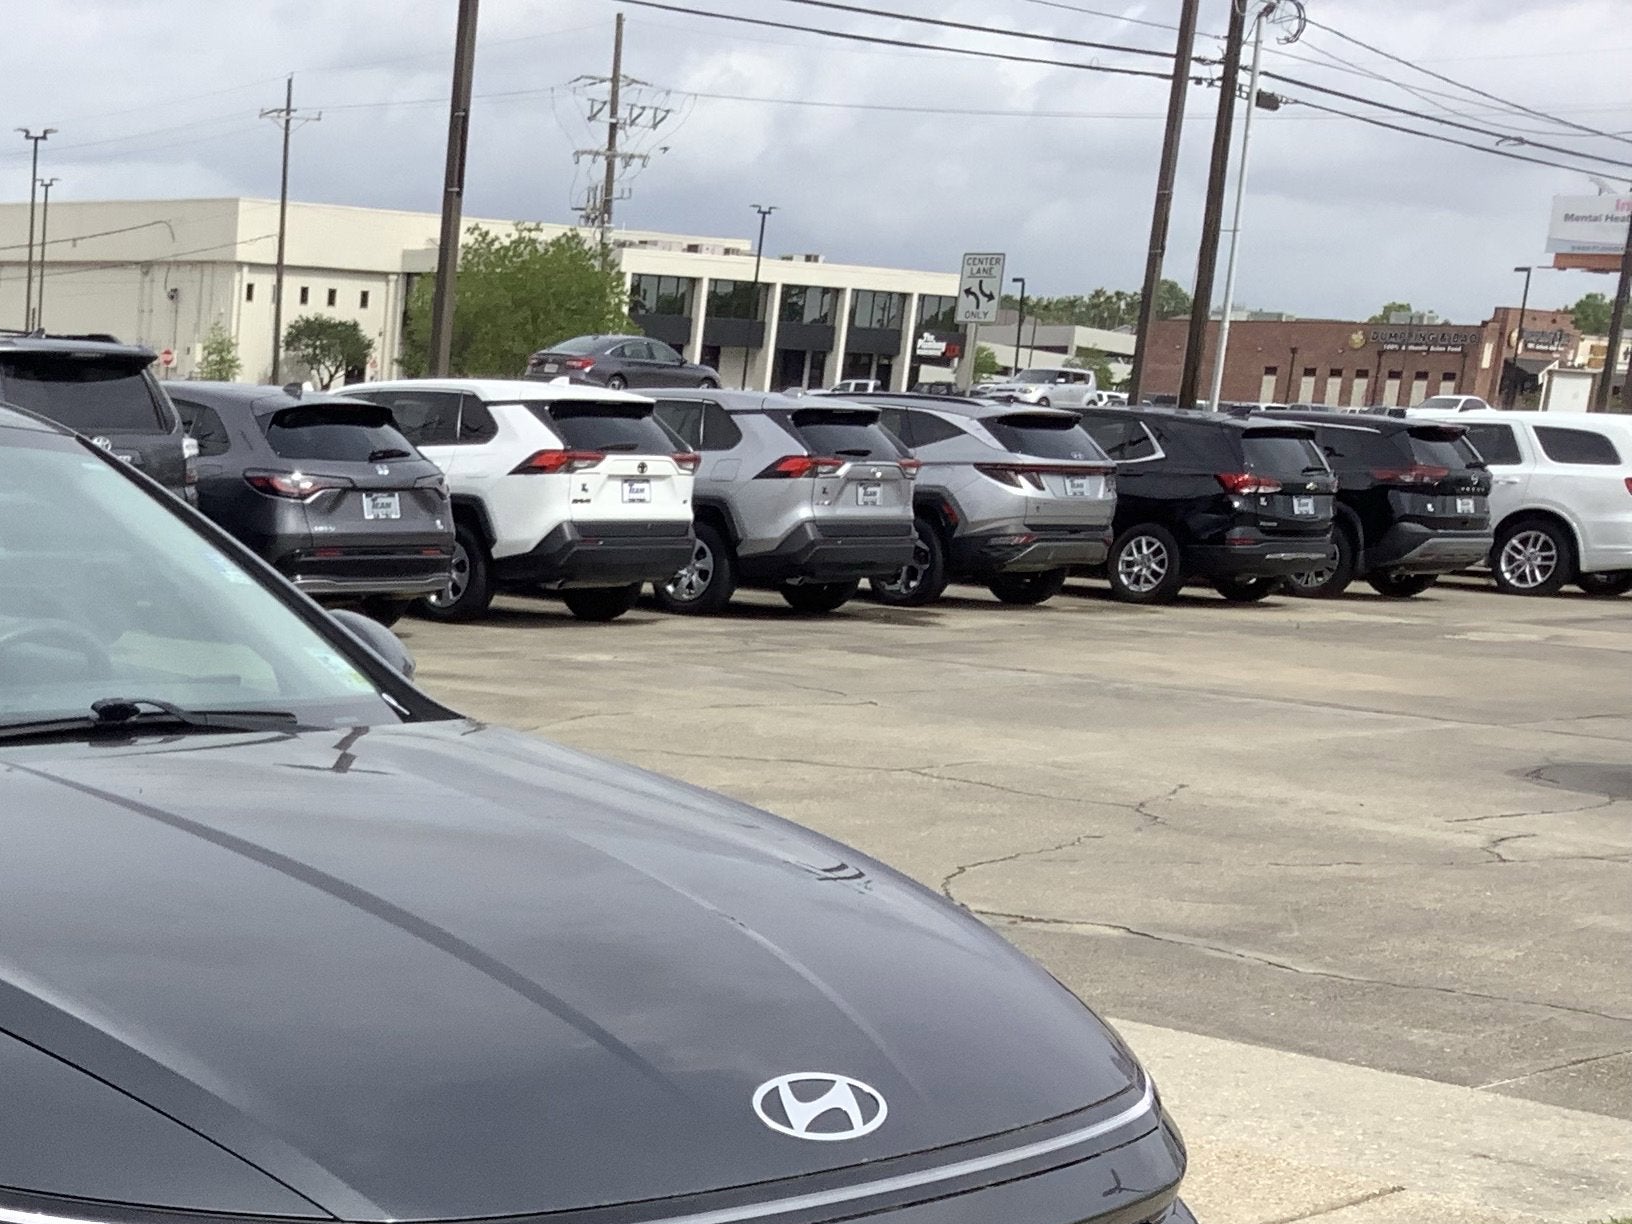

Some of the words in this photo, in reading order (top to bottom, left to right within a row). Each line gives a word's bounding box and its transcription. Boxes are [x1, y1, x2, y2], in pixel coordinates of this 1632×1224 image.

[1564, 213, 1603, 222] Mental
[1604, 214, 1631, 223] Heal
[966, 256, 1002, 266] CENTER
[970, 266, 995, 276] LANE
[964, 310, 989, 320] ONLY
